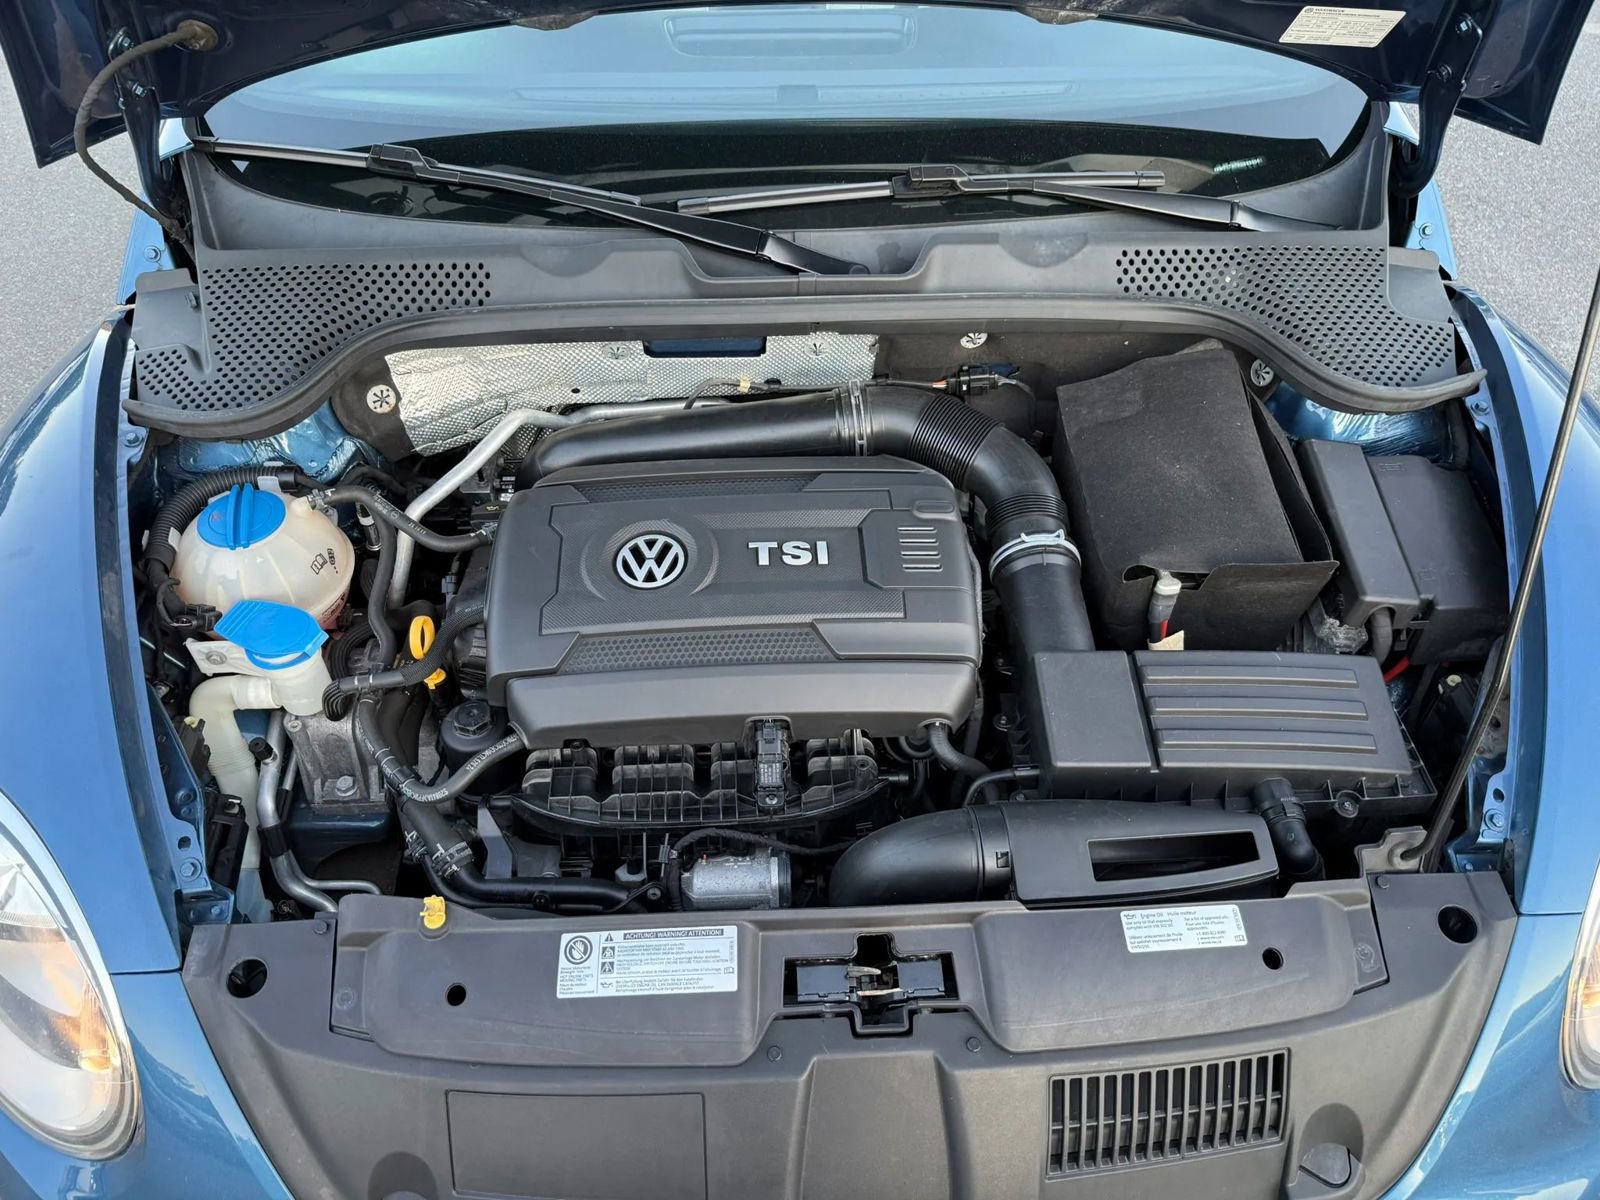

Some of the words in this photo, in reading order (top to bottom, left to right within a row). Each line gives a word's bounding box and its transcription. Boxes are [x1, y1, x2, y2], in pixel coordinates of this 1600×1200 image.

[616, 533, 685, 589] VW
[748, 540, 829, 566] TSI
[657, 930, 688, 938] WARNING!
[688, 929, 722, 937] ATTENTION!
